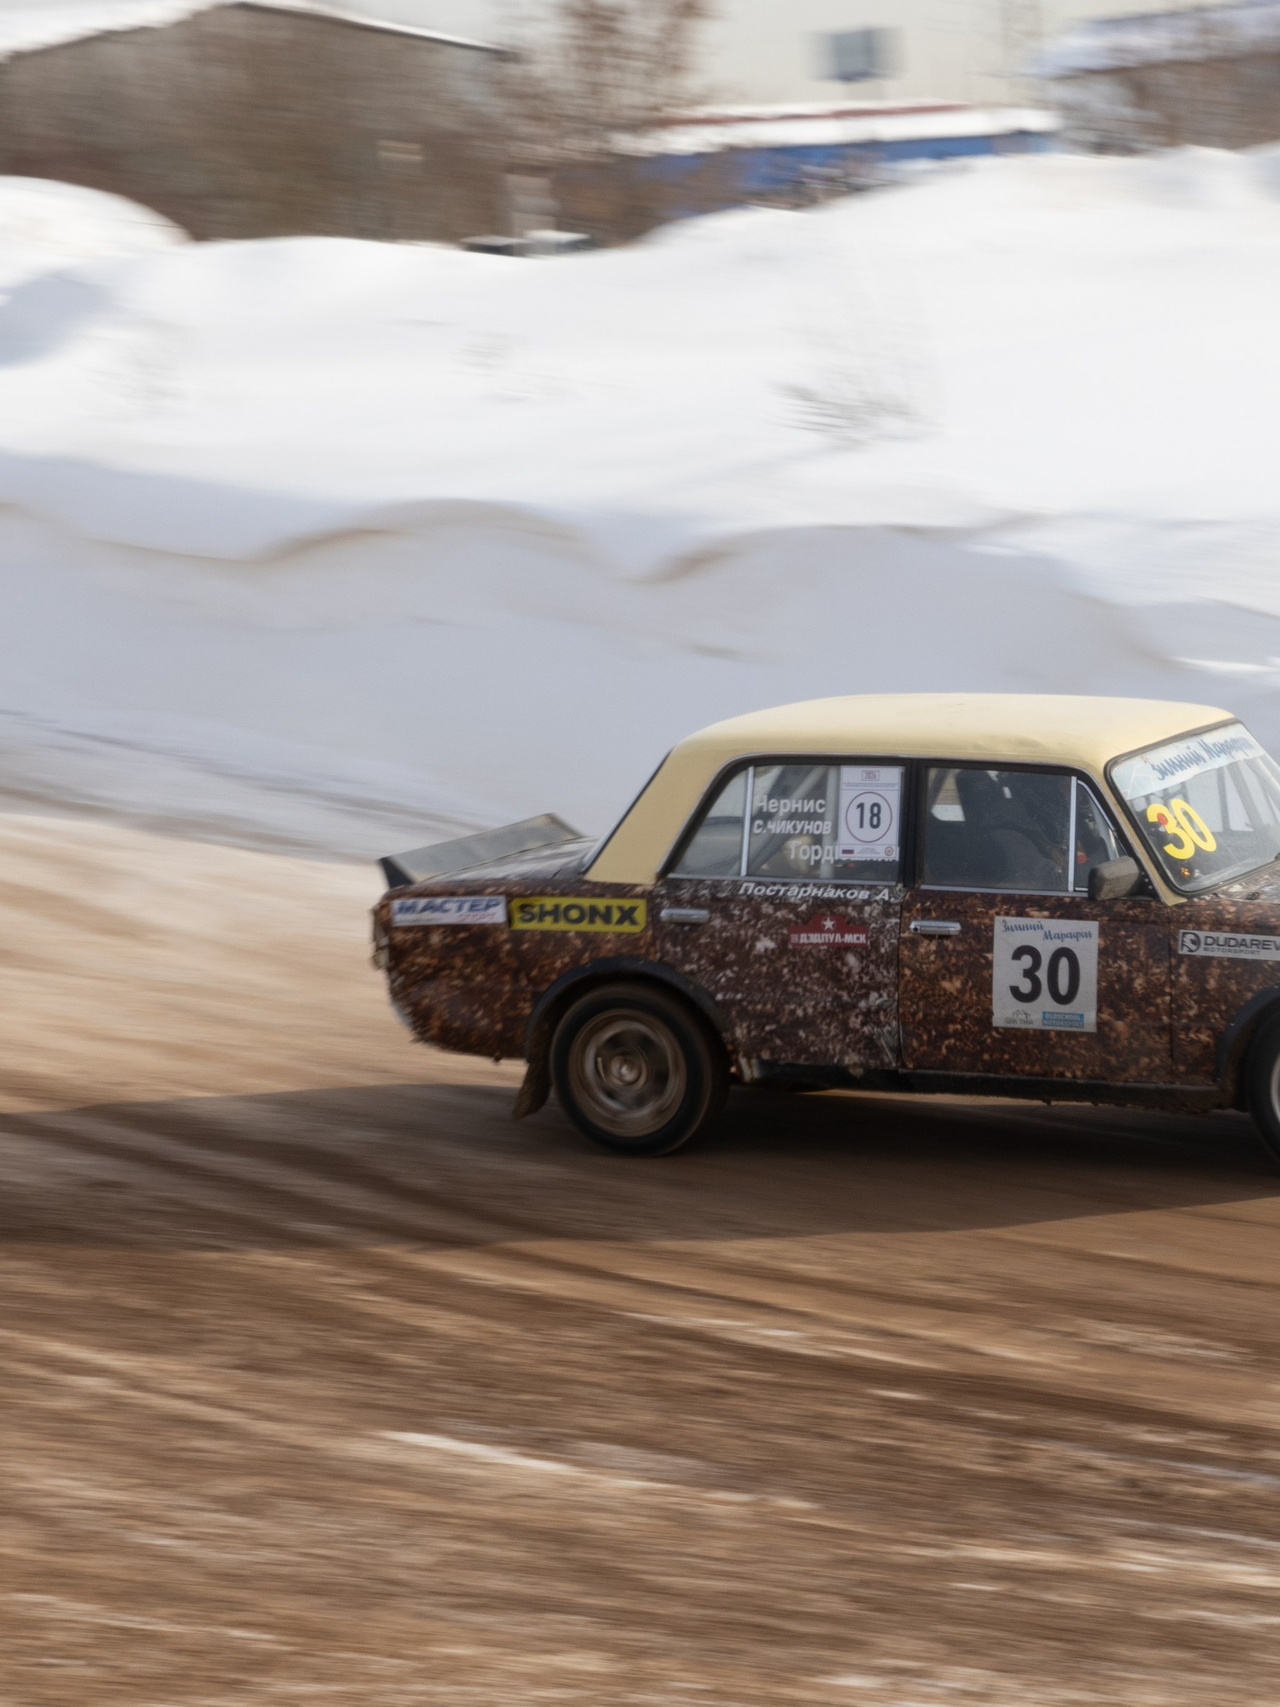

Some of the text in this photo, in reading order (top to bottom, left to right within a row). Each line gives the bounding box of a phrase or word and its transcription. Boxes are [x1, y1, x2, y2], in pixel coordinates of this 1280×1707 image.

[856, 802, 882, 829] 18
[1146, 798, 1217, 860] 30
[738, 882, 870, 899] Постарнаков
[394, 898, 503, 915] МАСТЕР
[518, 903, 640, 926] SHONX
[1002, 919, 1044, 933] Зимний
[1203, 946, 1261, 955] MOTORSPORT
[1009, 944, 1080, 1006] 30
